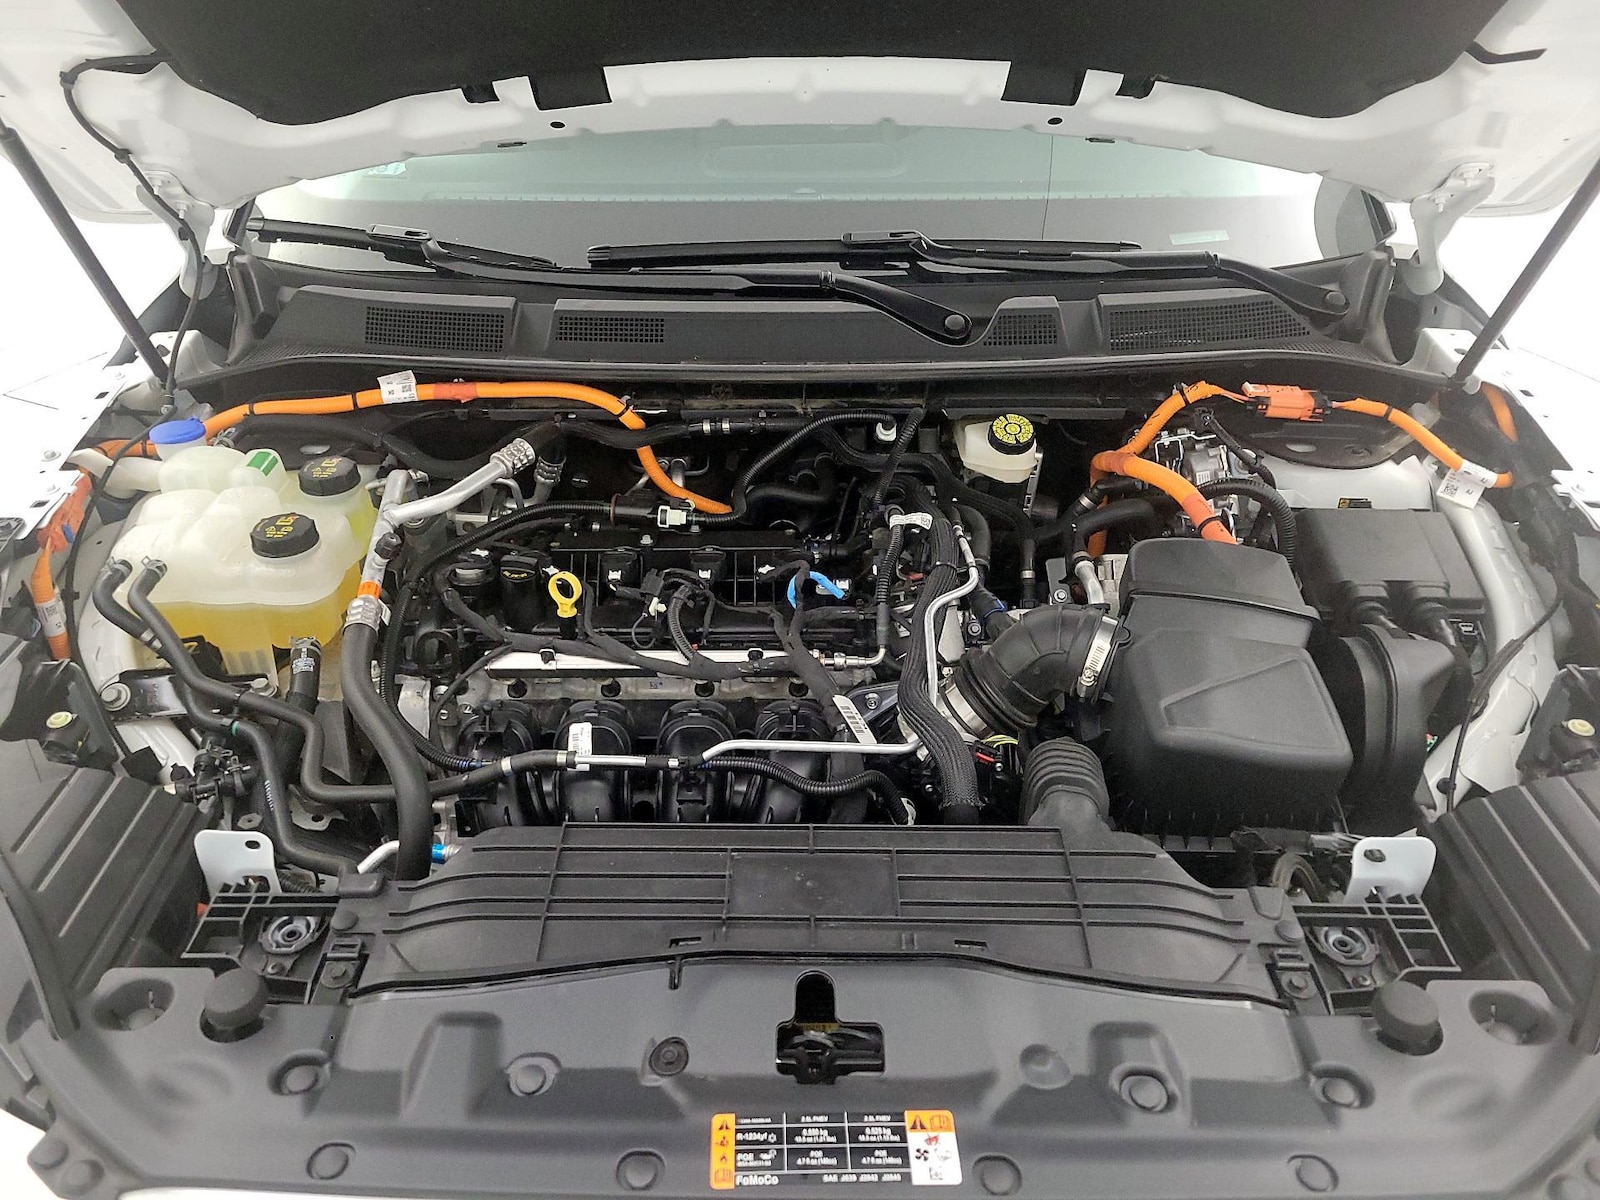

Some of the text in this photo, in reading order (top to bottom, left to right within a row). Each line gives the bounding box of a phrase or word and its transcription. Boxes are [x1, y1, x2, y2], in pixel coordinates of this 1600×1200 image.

[819, 1128, 828, 1137] kg
[883, 1127, 891, 1136] kg
[736, 1132, 768, 1141] R-1234yf
[736, 1175, 779, 1185] FoMoCo
[823, 1174, 838, 1182] SAE
